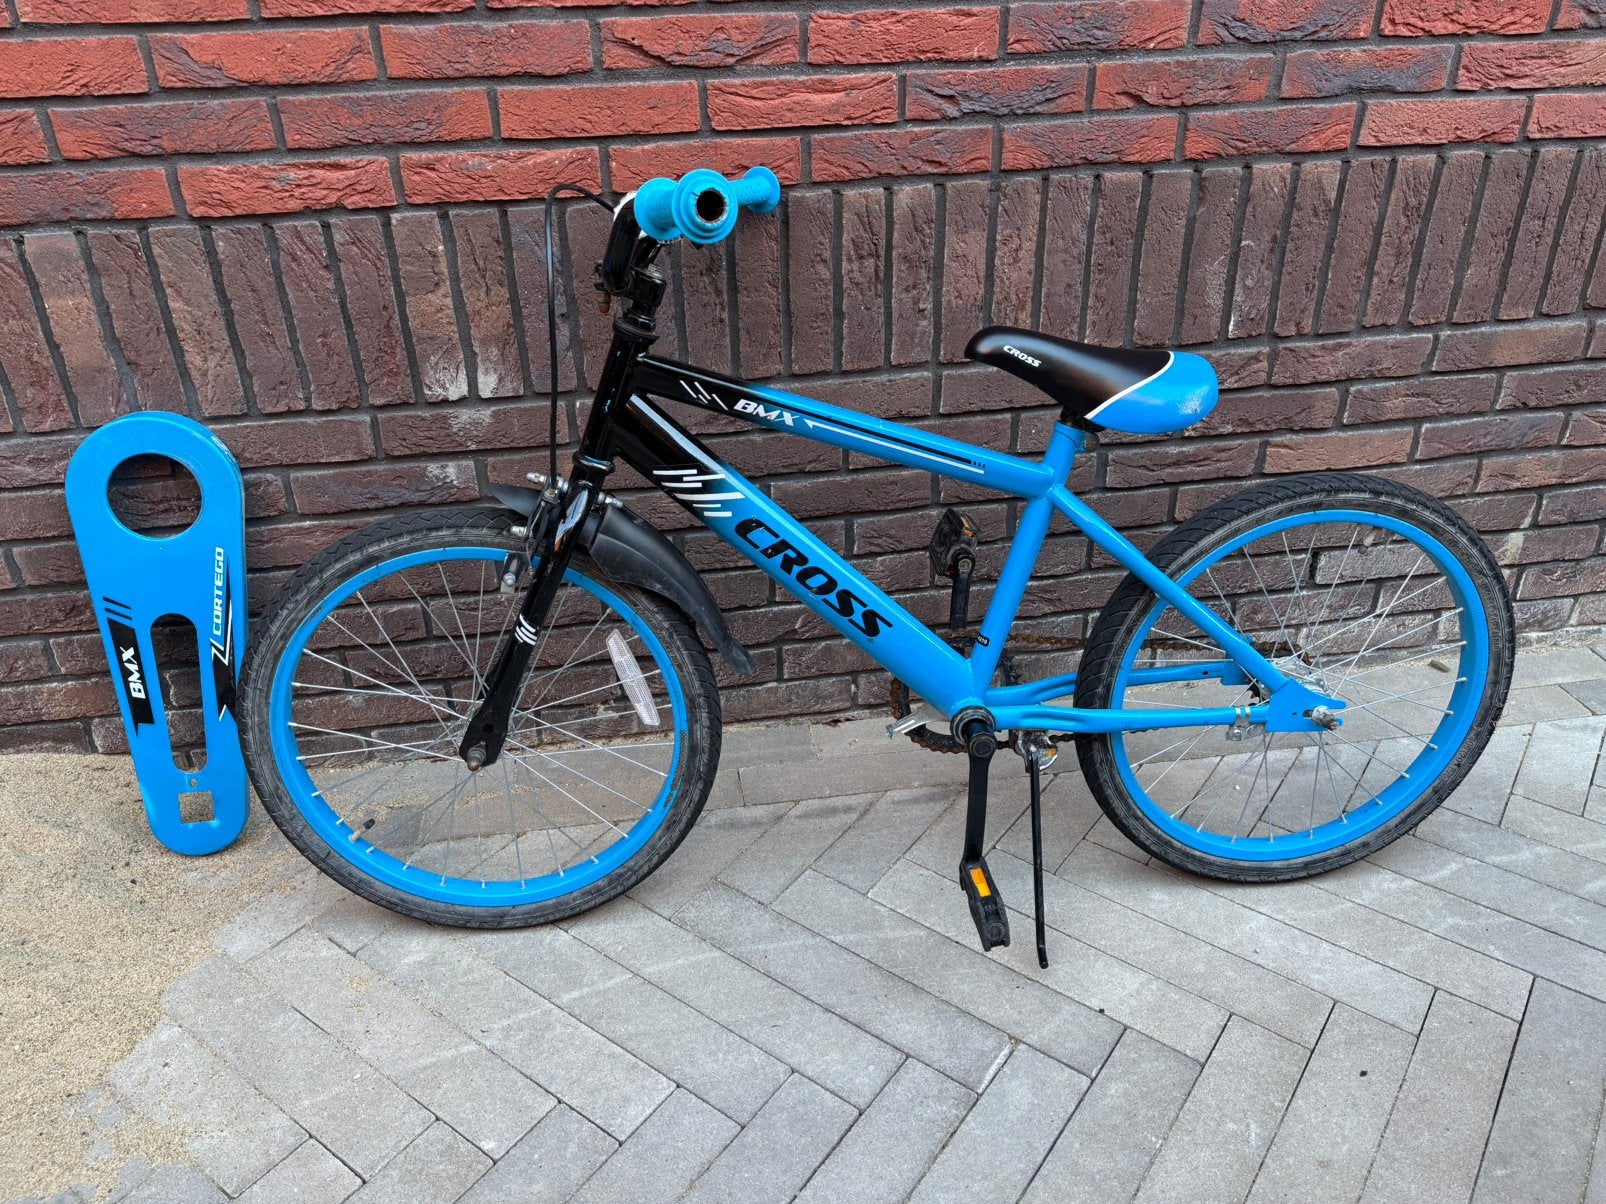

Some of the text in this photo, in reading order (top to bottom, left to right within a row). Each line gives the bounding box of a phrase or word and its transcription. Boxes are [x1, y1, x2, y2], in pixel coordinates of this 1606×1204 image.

[1003, 345, 1042, 368] CROSS
[733, 398, 800, 427] BMX
[212, 547, 225, 636] CORTEGO
[734, 517, 894, 638] CROSS
[119, 646, 146, 699] BMX
